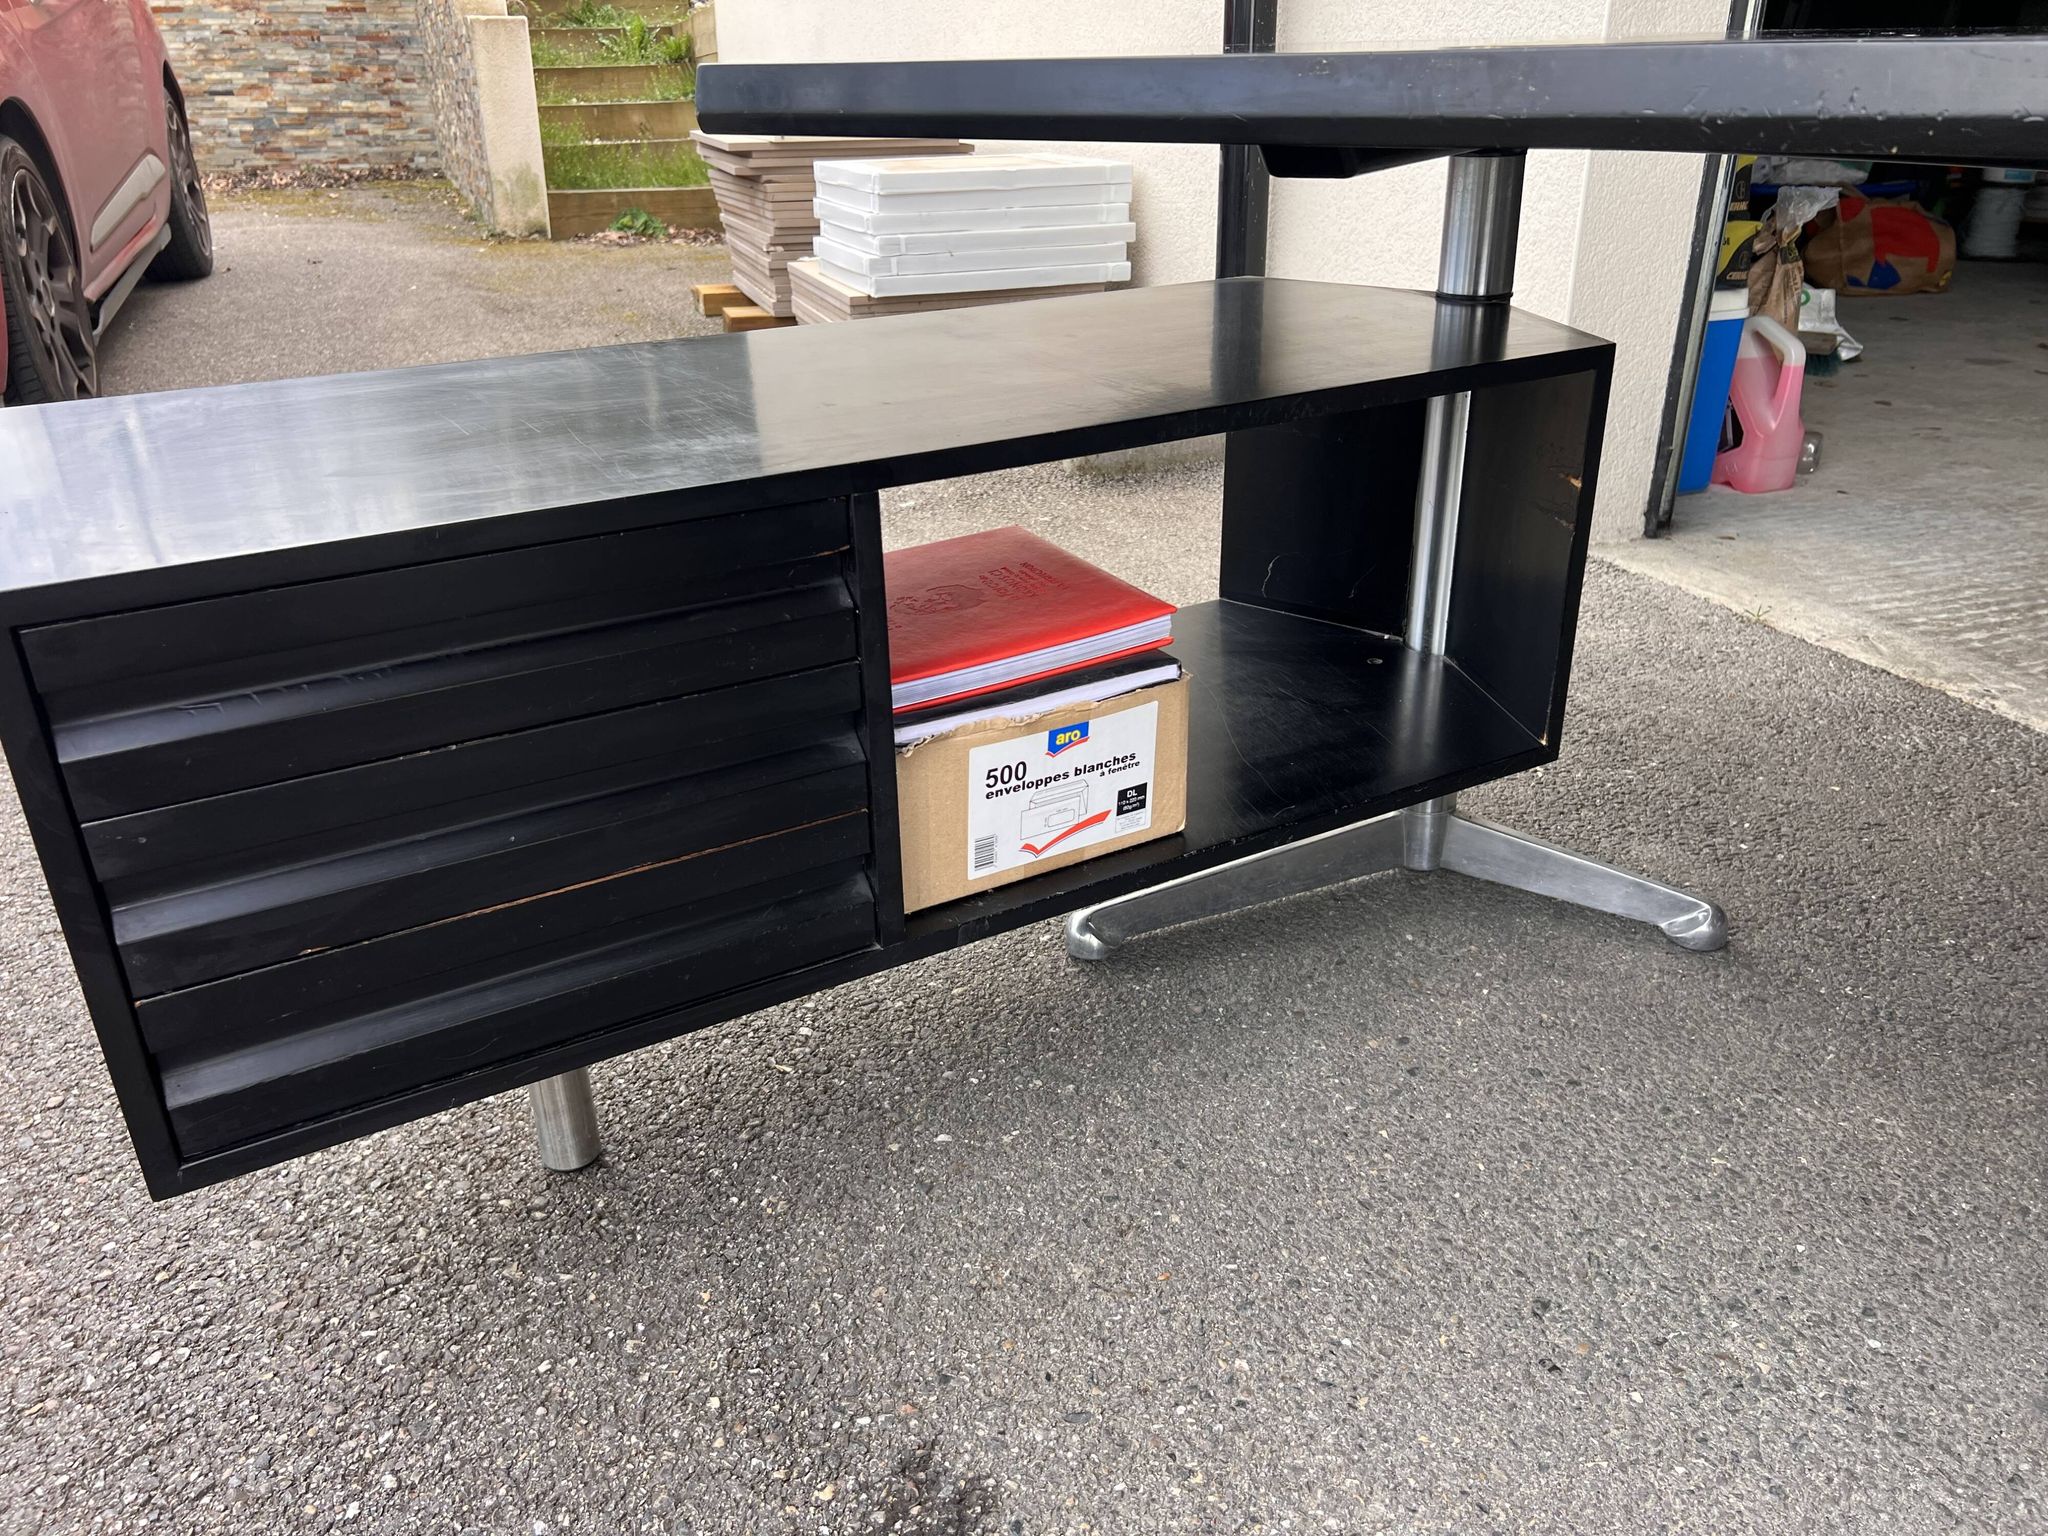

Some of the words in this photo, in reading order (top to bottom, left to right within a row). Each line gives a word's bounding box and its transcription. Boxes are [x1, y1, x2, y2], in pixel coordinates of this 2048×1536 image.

[1055, 729, 1081, 746] aro
[985, 761, 1027, 788] 500
[1108, 761, 1140, 774] fenêtre
[985, 770, 1070, 800] enveloppes
[1074, 753, 1136, 776] blanches
[1126, 789, 1138, 798] DL
